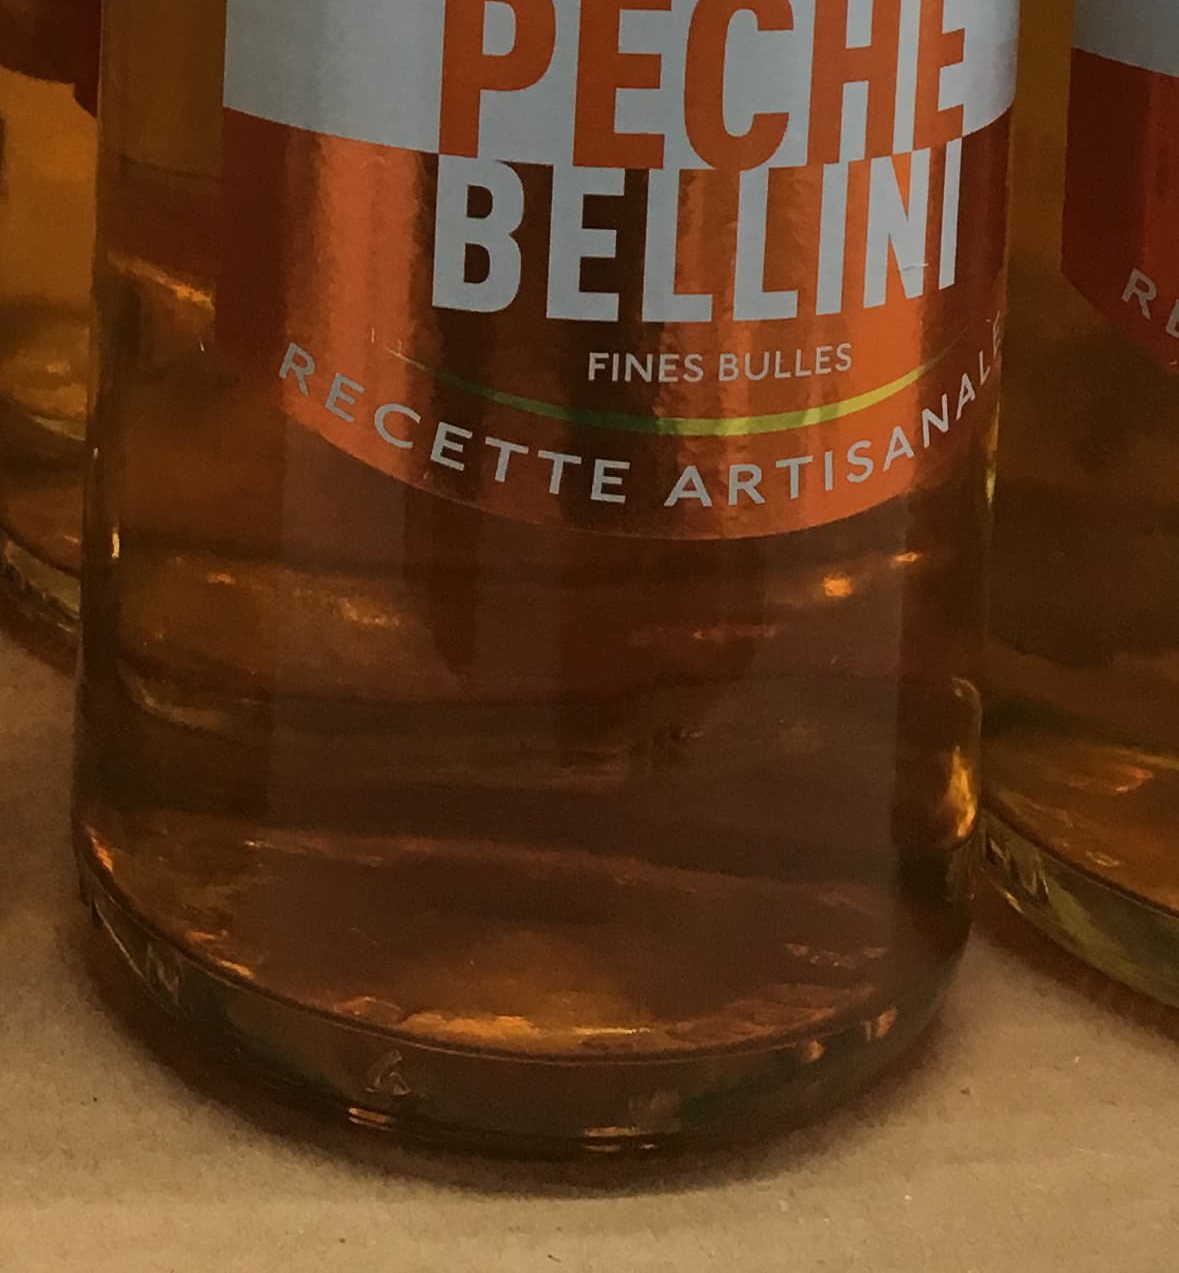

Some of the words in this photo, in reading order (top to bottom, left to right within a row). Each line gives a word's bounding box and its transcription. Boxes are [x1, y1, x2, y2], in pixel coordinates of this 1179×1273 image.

[431, 137, 962, 323] BELLINI
[278, 342, 632, 505] RECETTE
[663, 310, 1003, 509] ARTISANALE
[588, 351, 704, 383] FINES
[718, 342, 853, 383] BULLES
